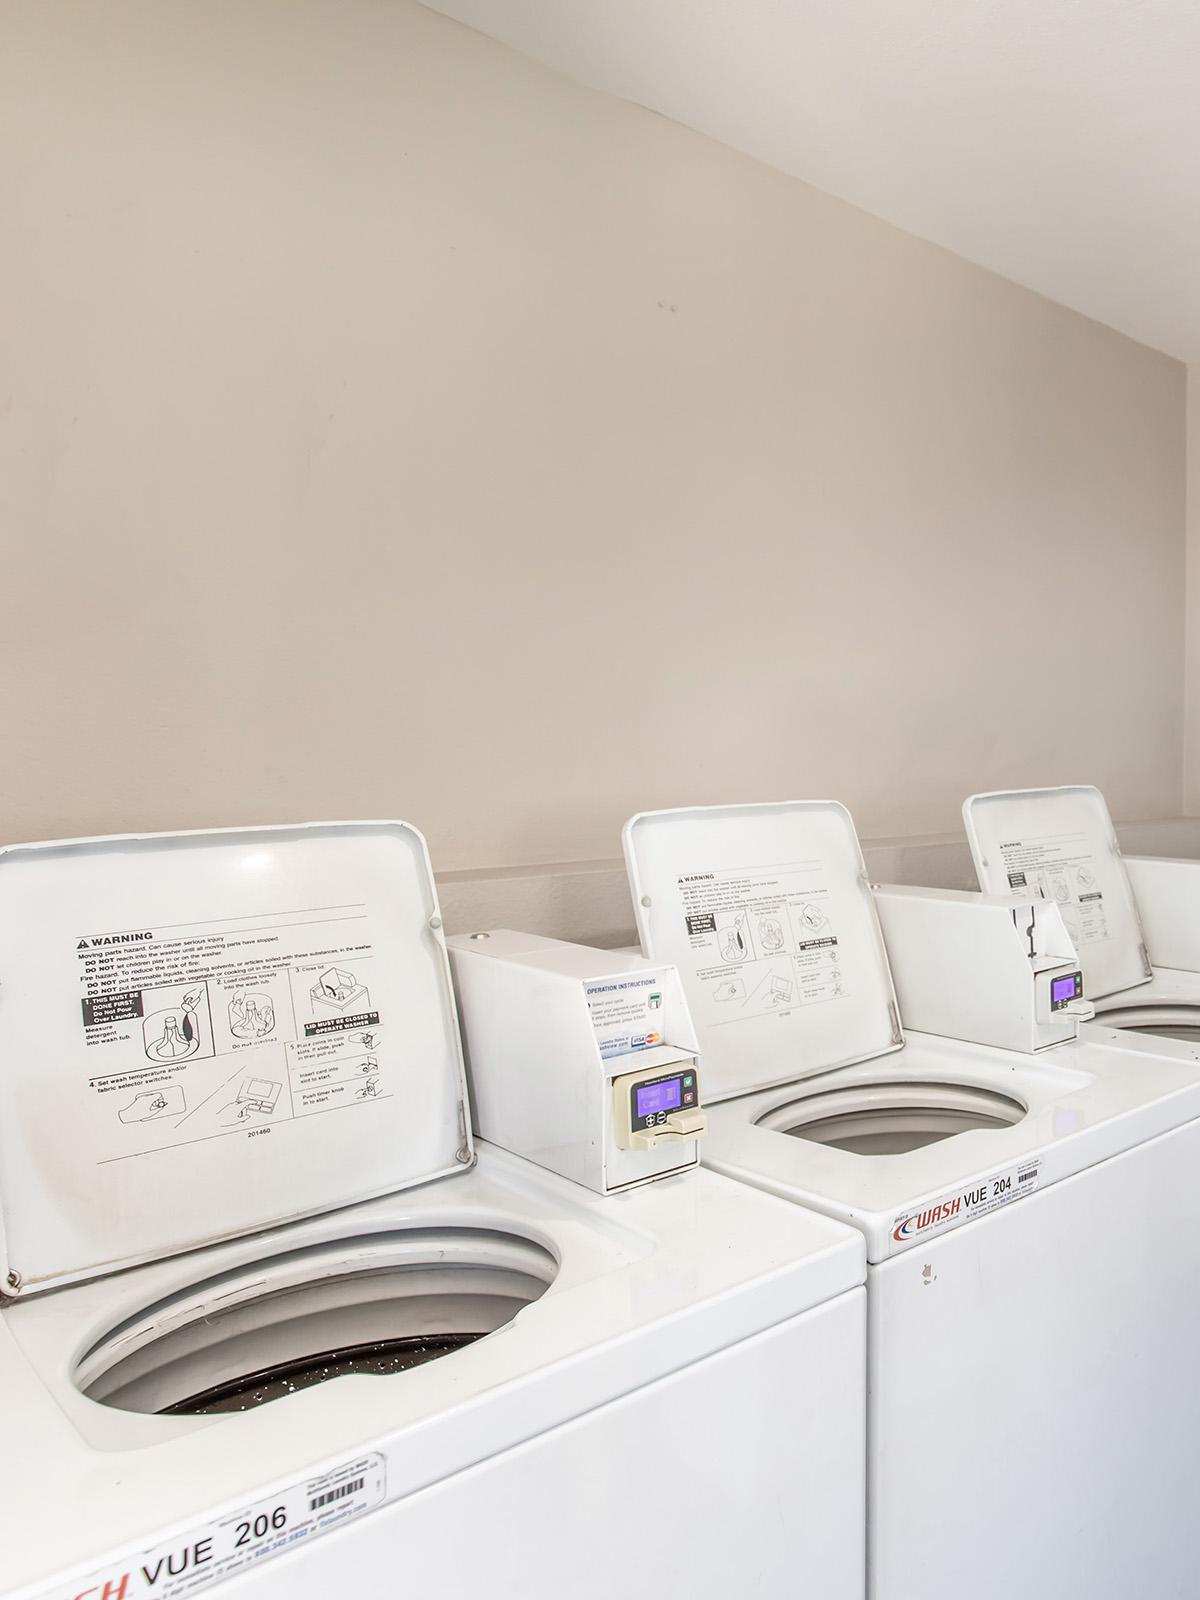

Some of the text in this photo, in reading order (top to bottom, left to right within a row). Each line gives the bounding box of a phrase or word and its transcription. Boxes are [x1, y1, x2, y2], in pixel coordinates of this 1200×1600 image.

[684, 873, 715, 883] WARNING
[91, 932, 152, 946] WARNING
[587, 978, 657, 996] OPERATION INSTRUCTIONS
[317, 1019, 334, 1027] MUST
[345, 1014, 368, 1022] CLOSED
[85, 1025, 112, 1033] Measure
[916, 1197, 961, 1230] WASH
[963, 1186, 988, 1208] VUE
[993, 1176, 1012, 1196] 204
[141, 1537, 215, 1586] VUE
[234, 1506, 288, 1548] 206
